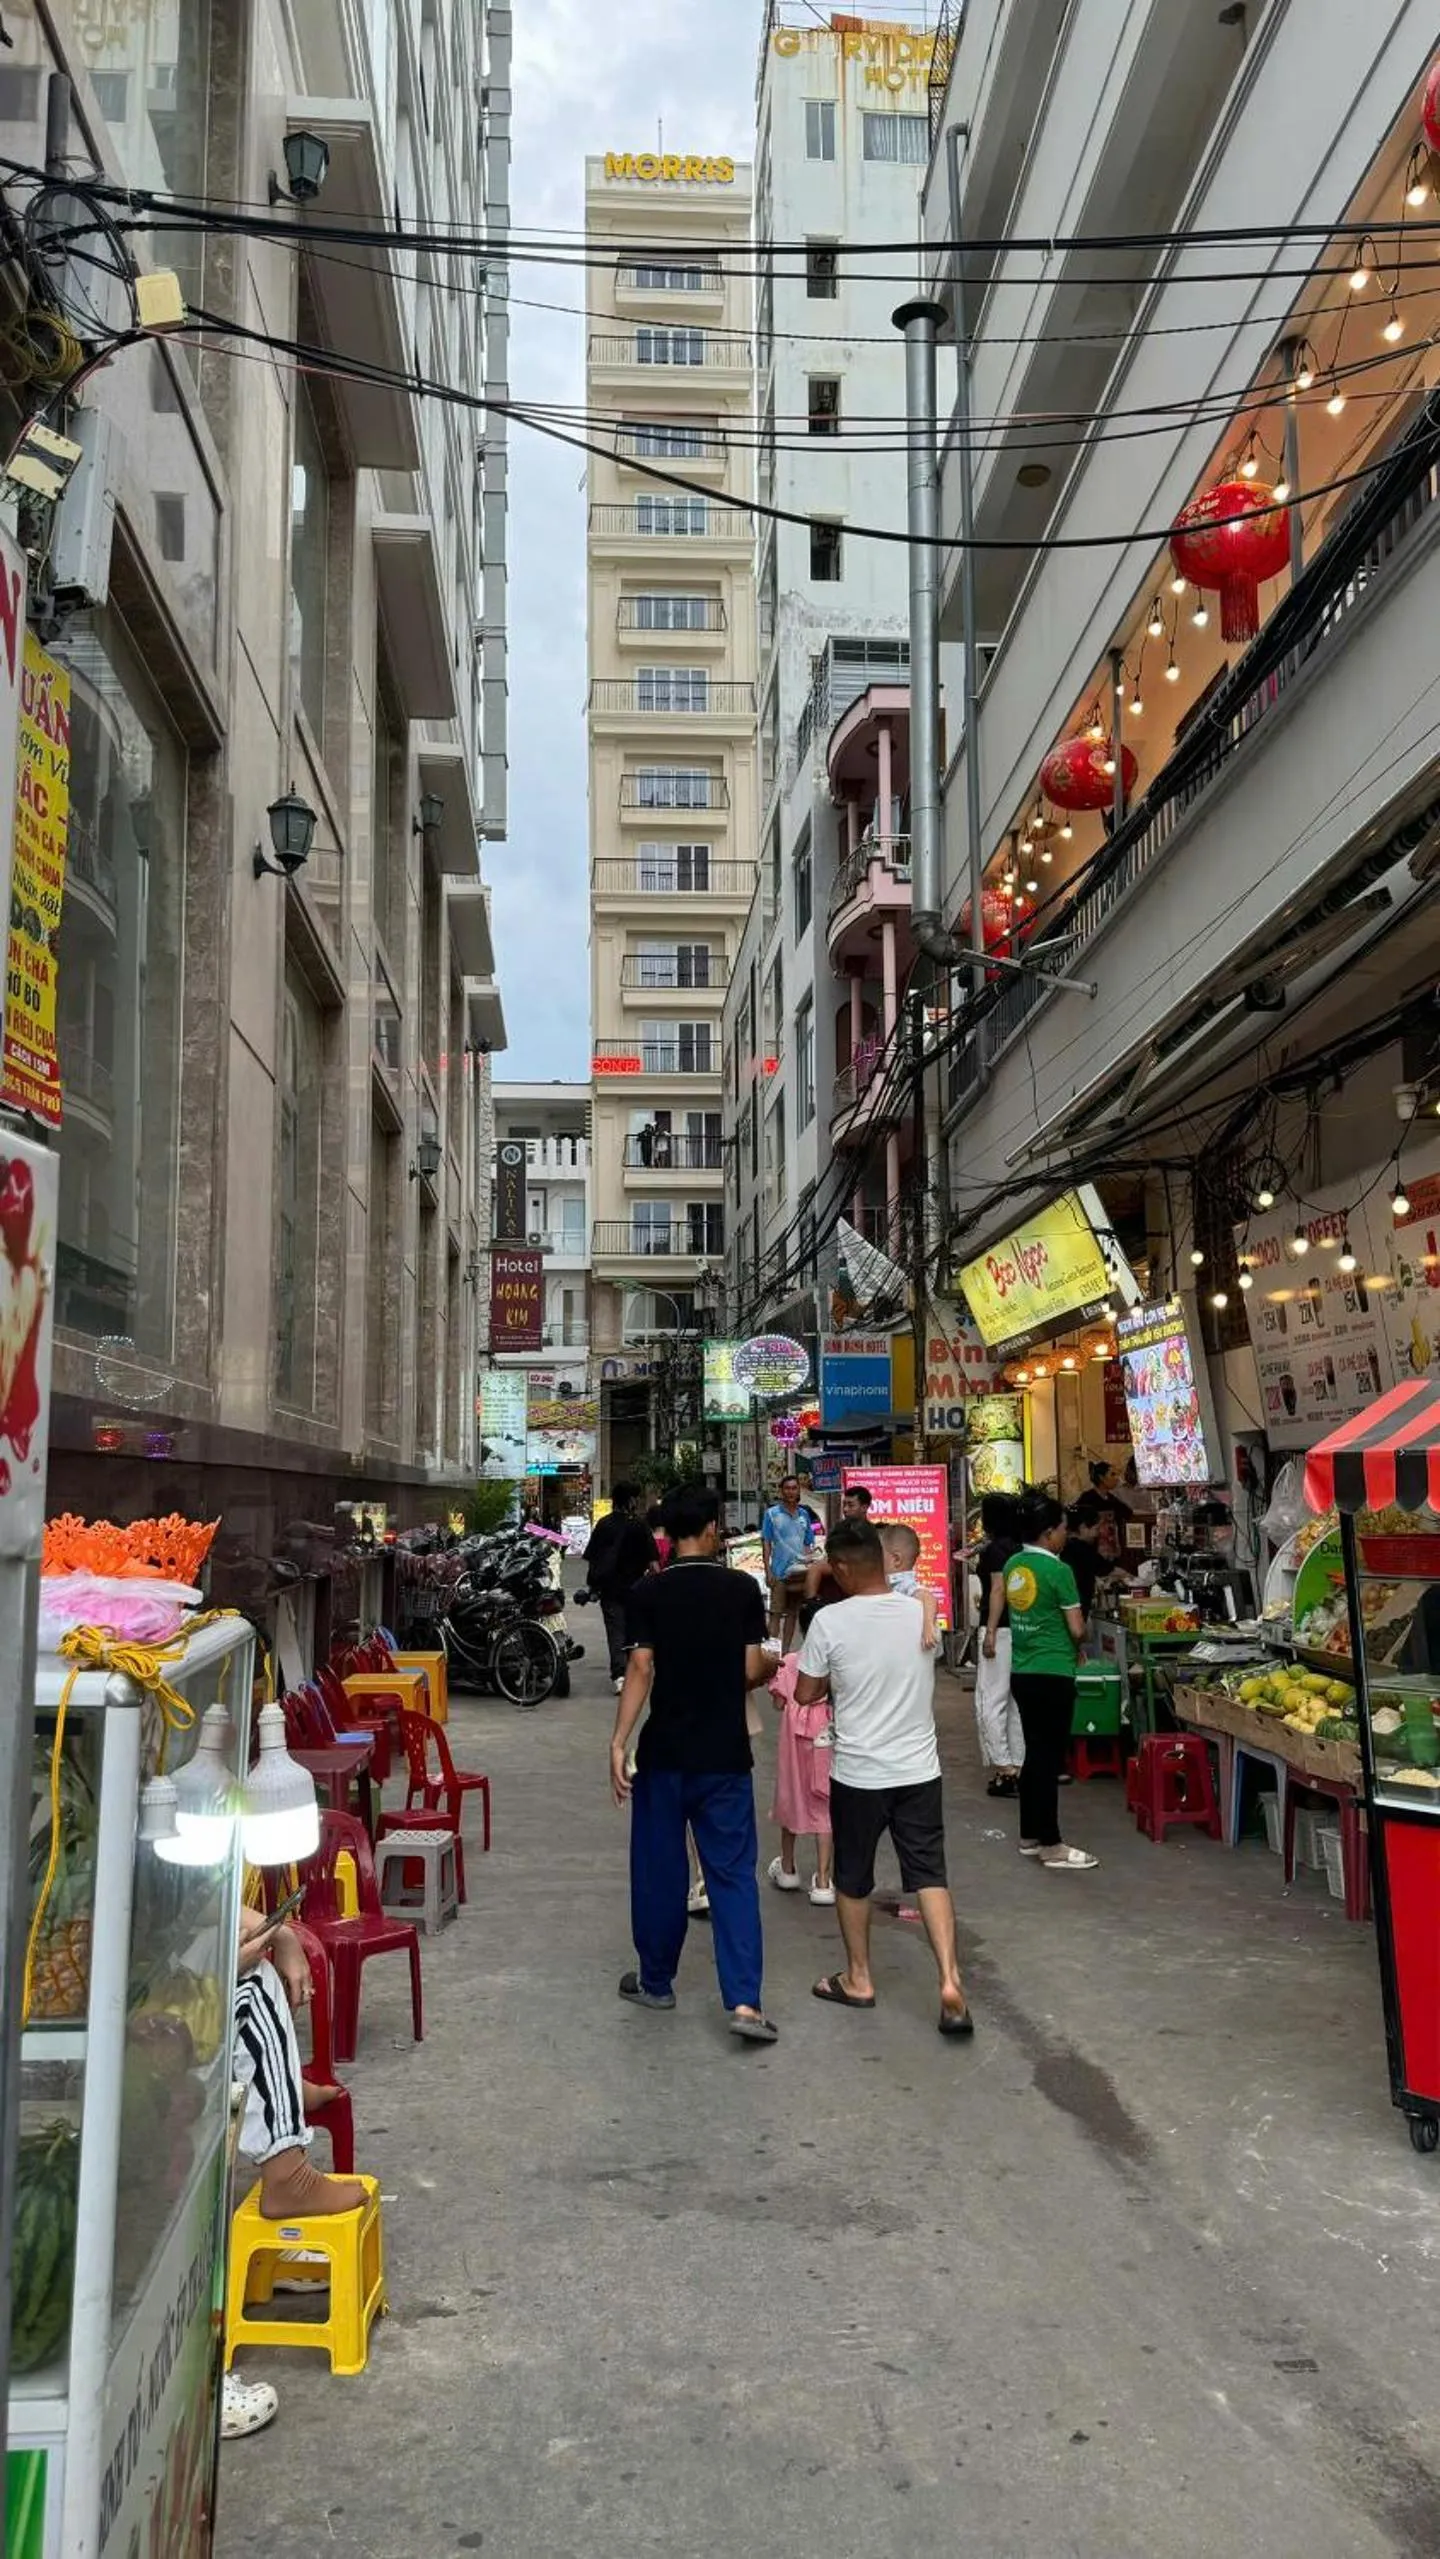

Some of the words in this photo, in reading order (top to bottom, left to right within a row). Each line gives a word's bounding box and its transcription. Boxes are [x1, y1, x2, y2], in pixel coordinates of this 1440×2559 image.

[496, 1257, 540, 1274] Hotel
[825, 1384, 889, 1400] vinaphone
[729, 1430, 738, 1487] HOTEL
